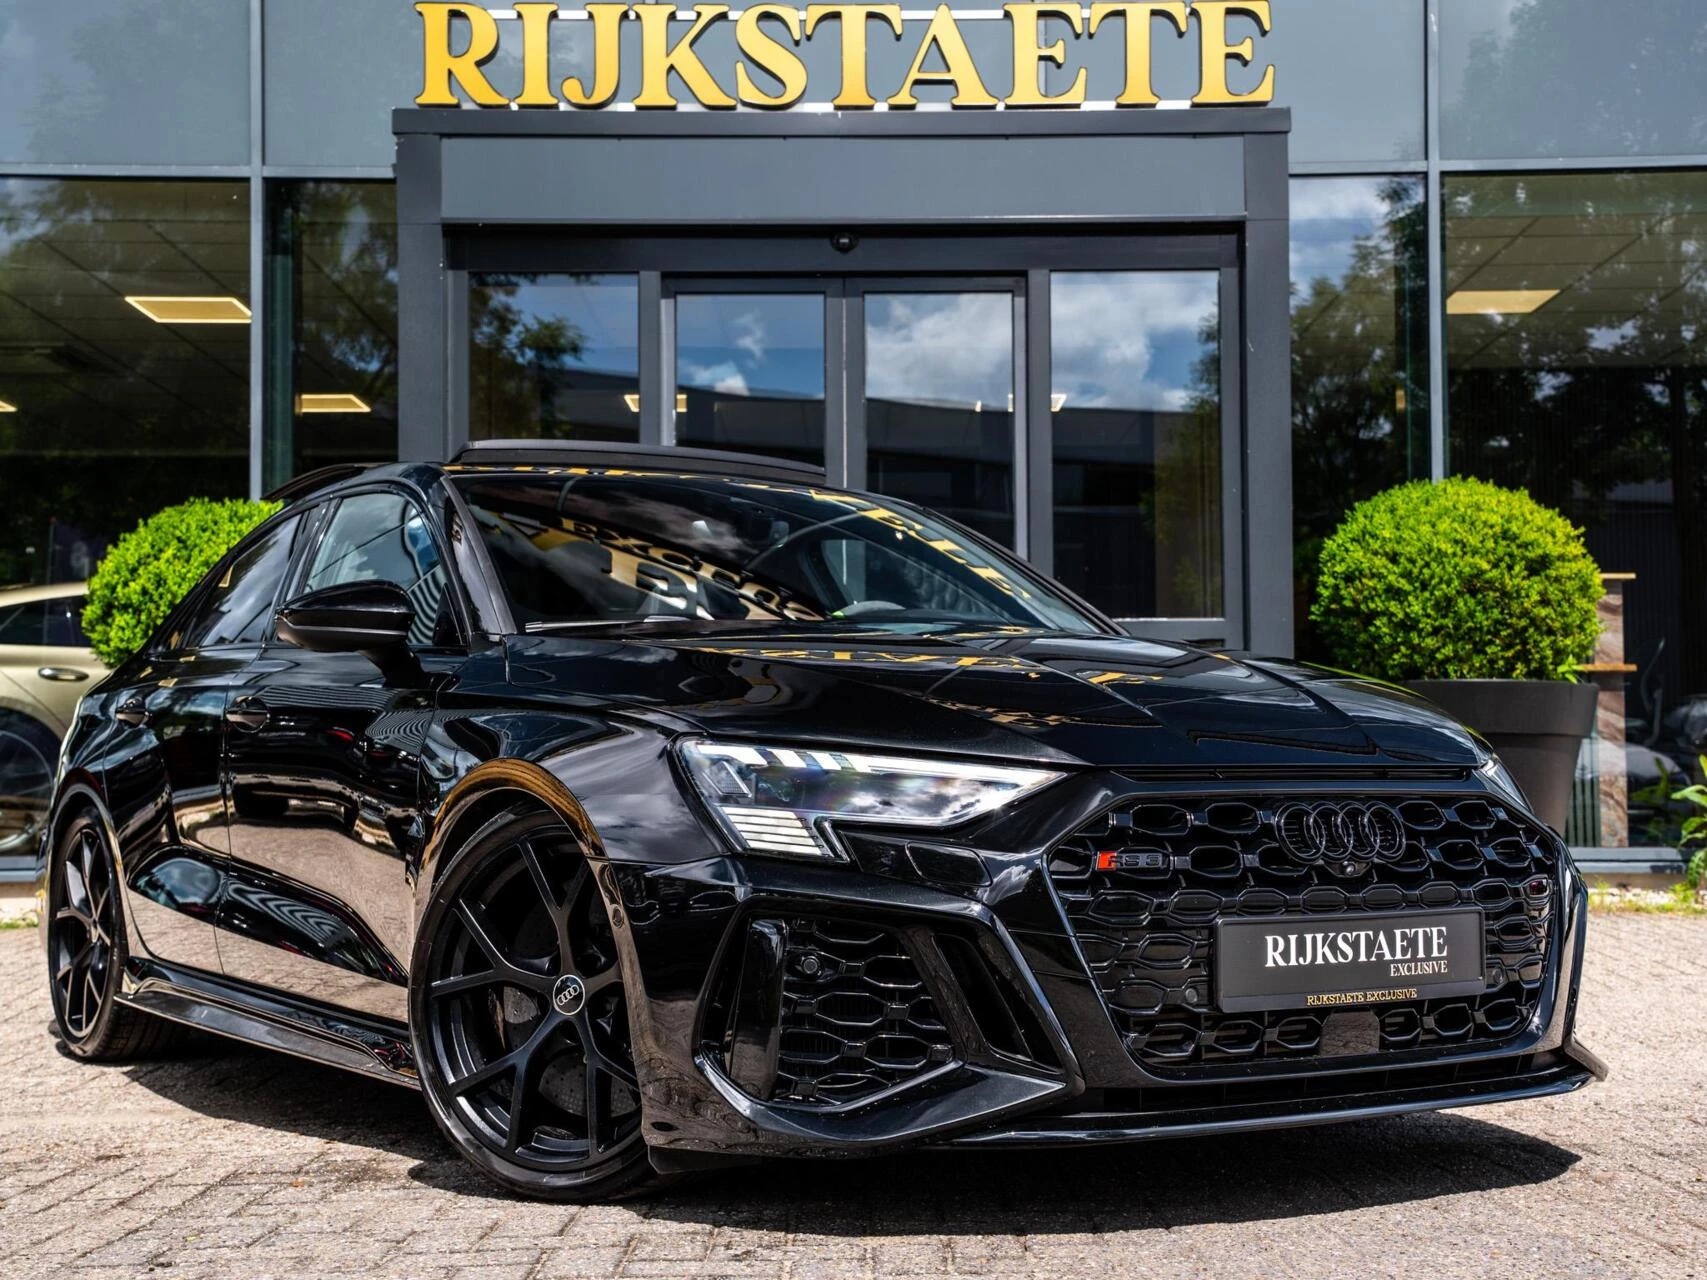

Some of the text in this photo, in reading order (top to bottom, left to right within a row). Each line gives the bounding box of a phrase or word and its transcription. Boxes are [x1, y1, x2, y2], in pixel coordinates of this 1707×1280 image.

[415, 1, 1276, 109] RIJKSTAETE
[1264, 926, 1448, 968] RIJKSTAETE
[1390, 961, 1448, 977] EXCLUSIVE
[1306, 988, 1418, 1006] RIJKSTAETE EXCLUSIVE
